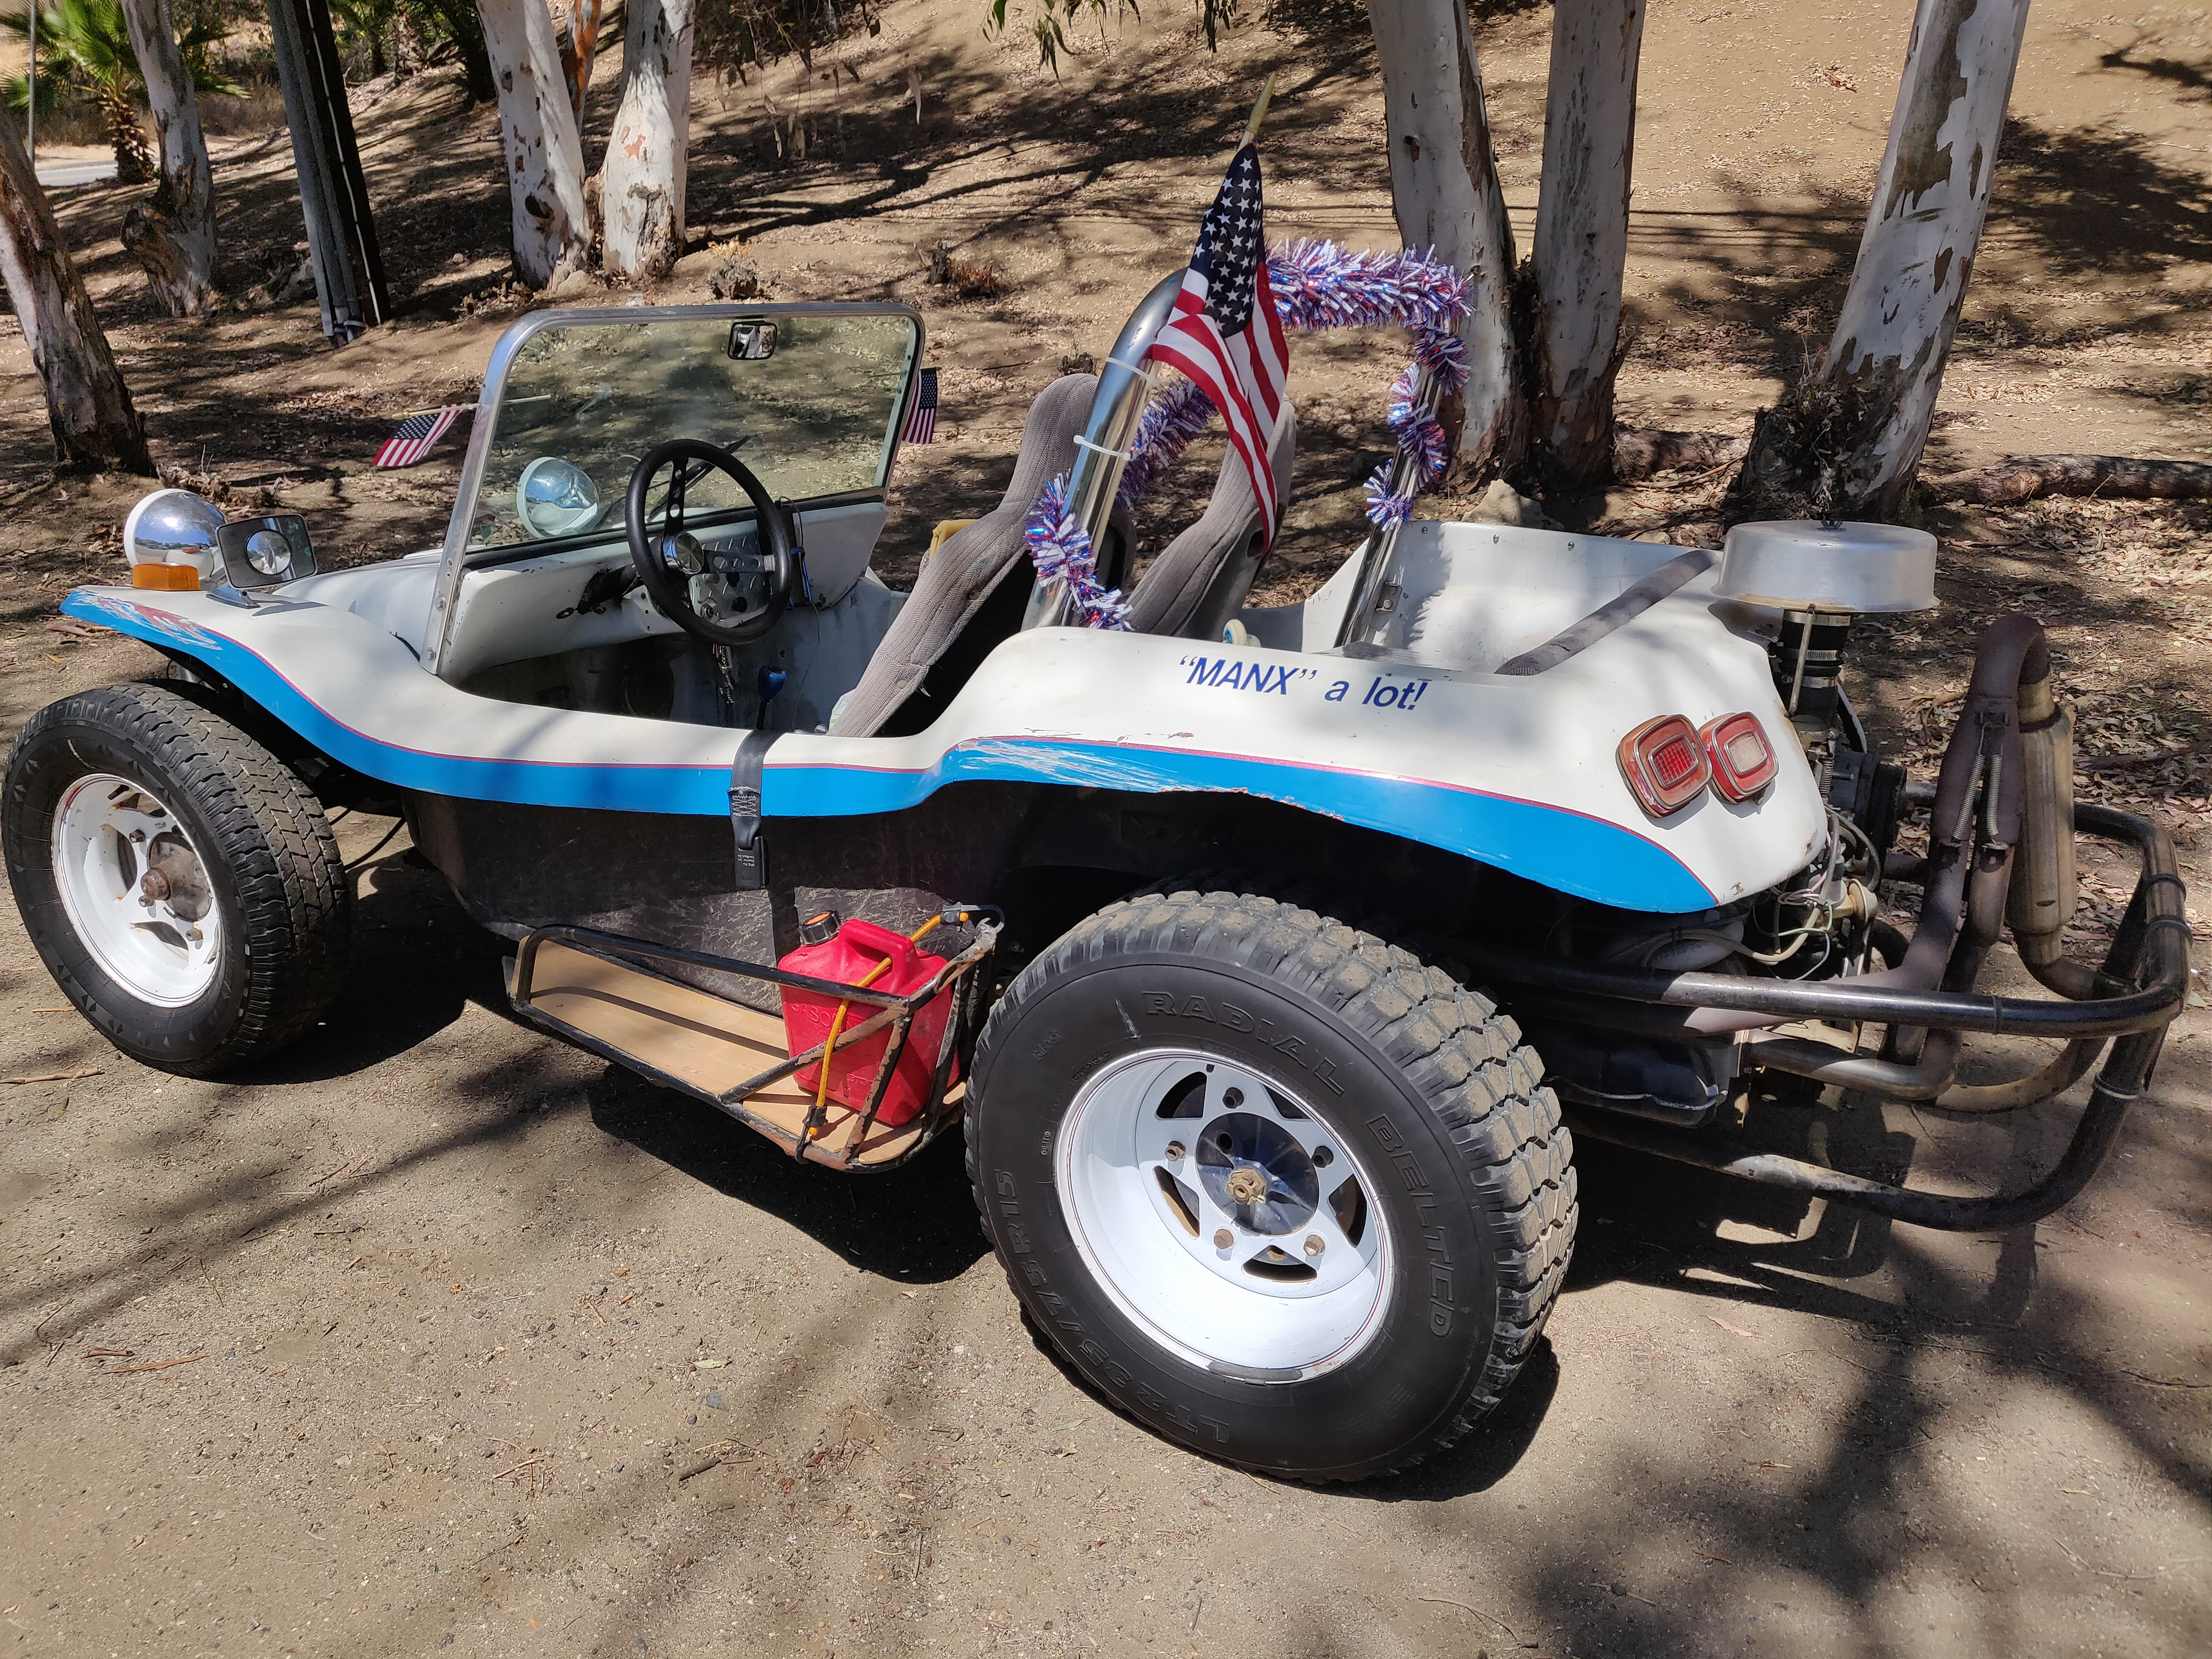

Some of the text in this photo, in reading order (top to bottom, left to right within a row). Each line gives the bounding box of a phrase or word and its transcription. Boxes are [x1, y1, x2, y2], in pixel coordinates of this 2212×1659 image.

[1324, 680, 1350, 702] a
[1361, 676, 1429, 710] lot!
[1032, 1030, 1060, 1061] M+S
[1142, 991, 1345, 1097] RADIAL
[1366, 1114, 1455, 1337] BELTED
